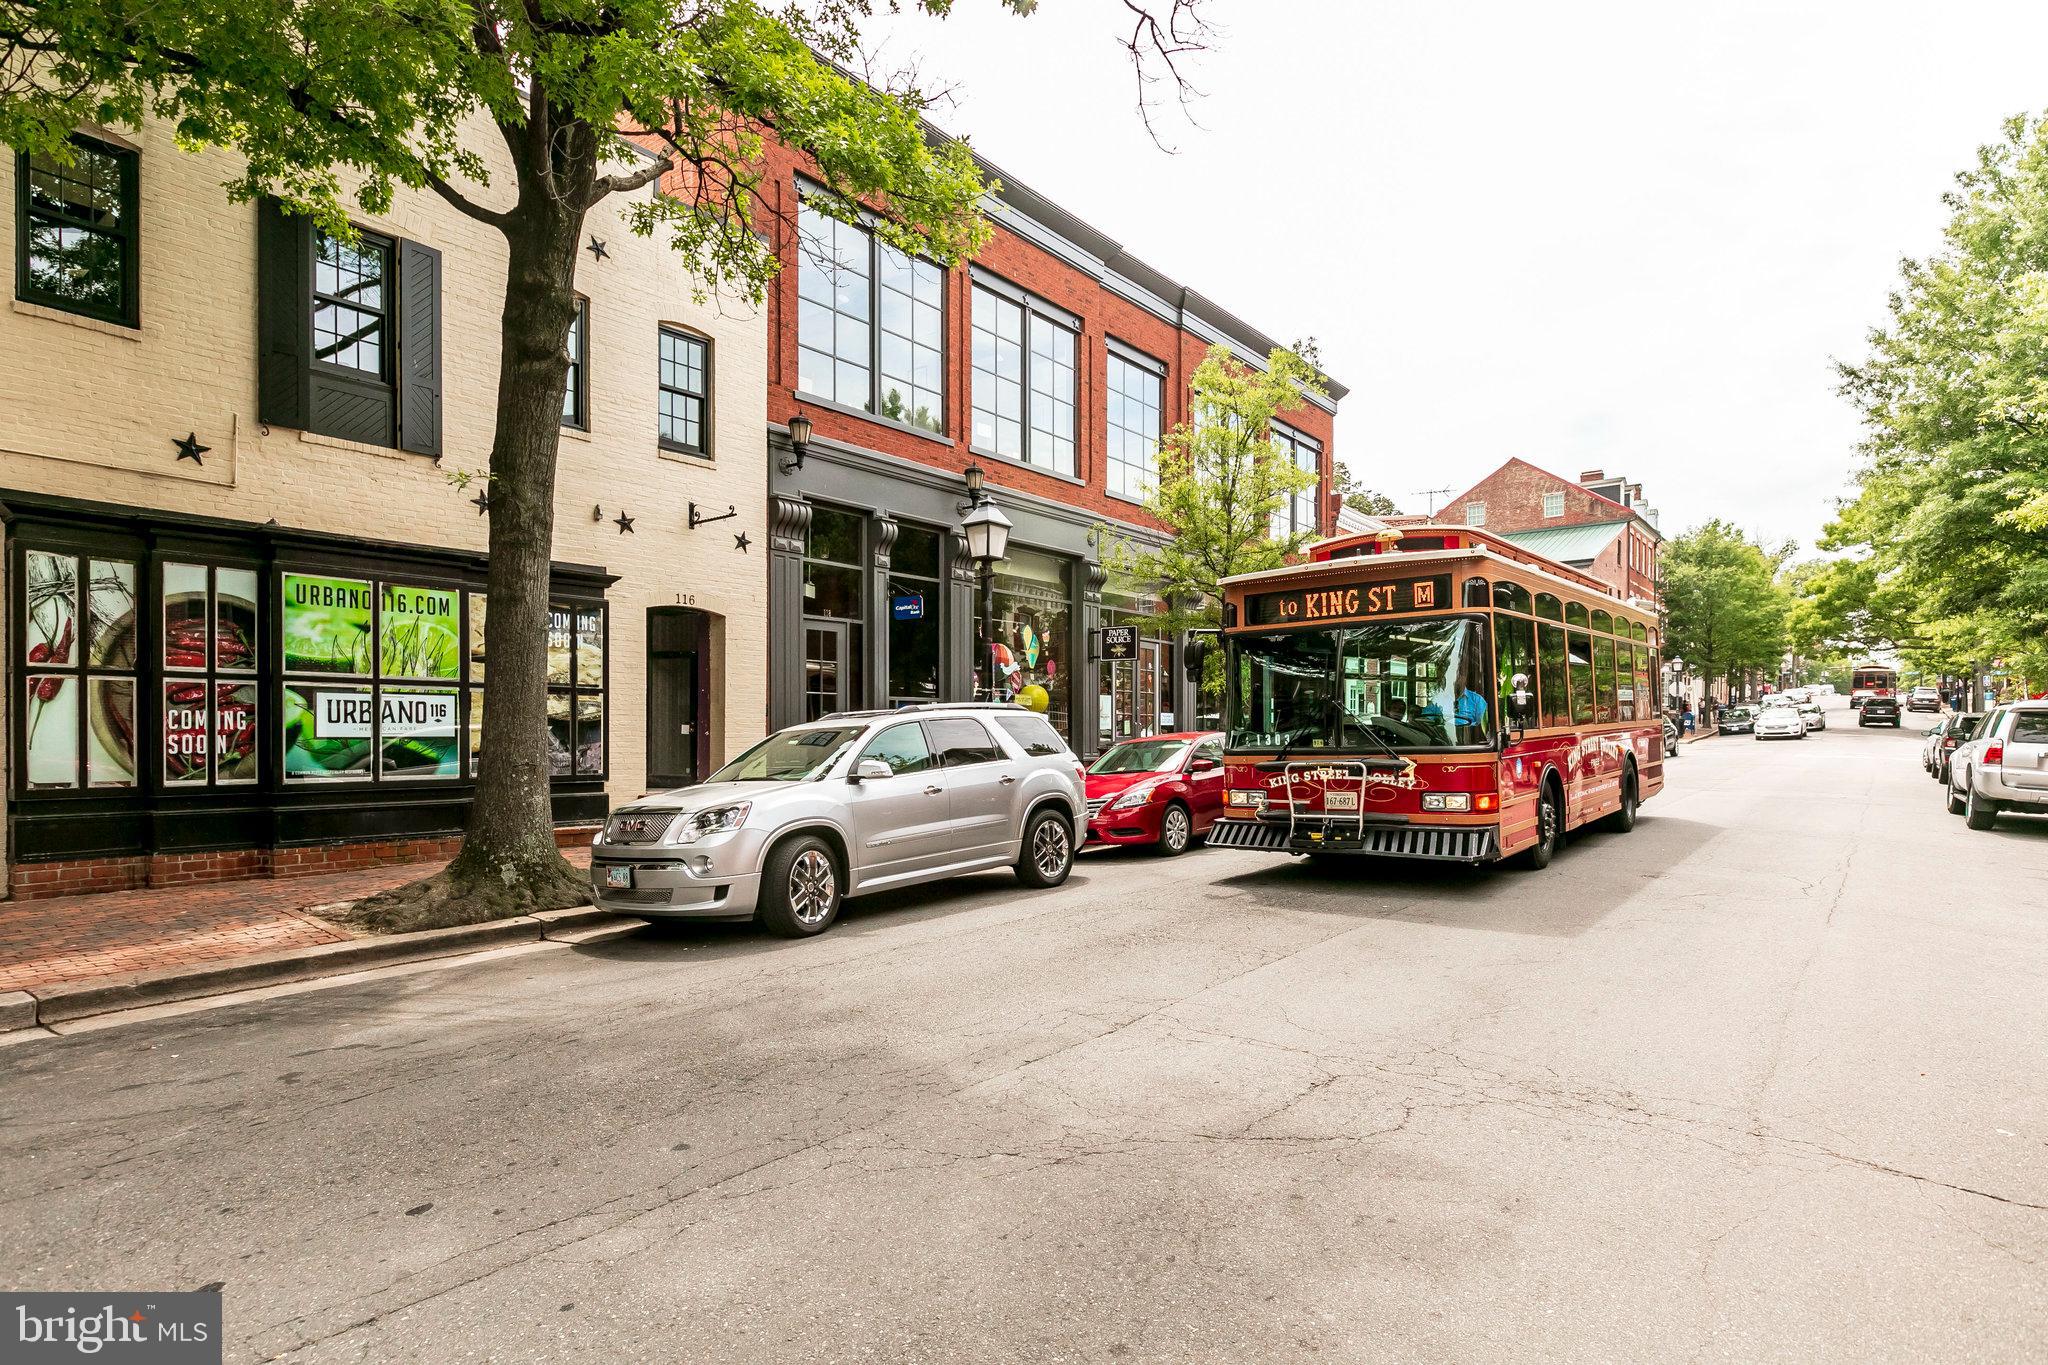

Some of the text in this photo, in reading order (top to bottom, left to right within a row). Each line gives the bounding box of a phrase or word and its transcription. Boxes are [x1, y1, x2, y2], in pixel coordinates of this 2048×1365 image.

[675, 593, 695, 606] 116
[1279, 599, 1298, 616] to
[1306, 588, 1360, 618] KING
[1368, 585, 1397, 613] ST
[1105, 635, 1132, 644] SOURCE
[1108, 628, 1129, 637] PAPER
[326, 699, 447, 724] URBANO 116
[167, 708, 247, 731] COMING
[167, 733, 227, 755] SOON
[1256, 733, 1290, 746] 1303
[1268, 773, 1300, 789] KING
[619, 820, 647, 832] GMC
